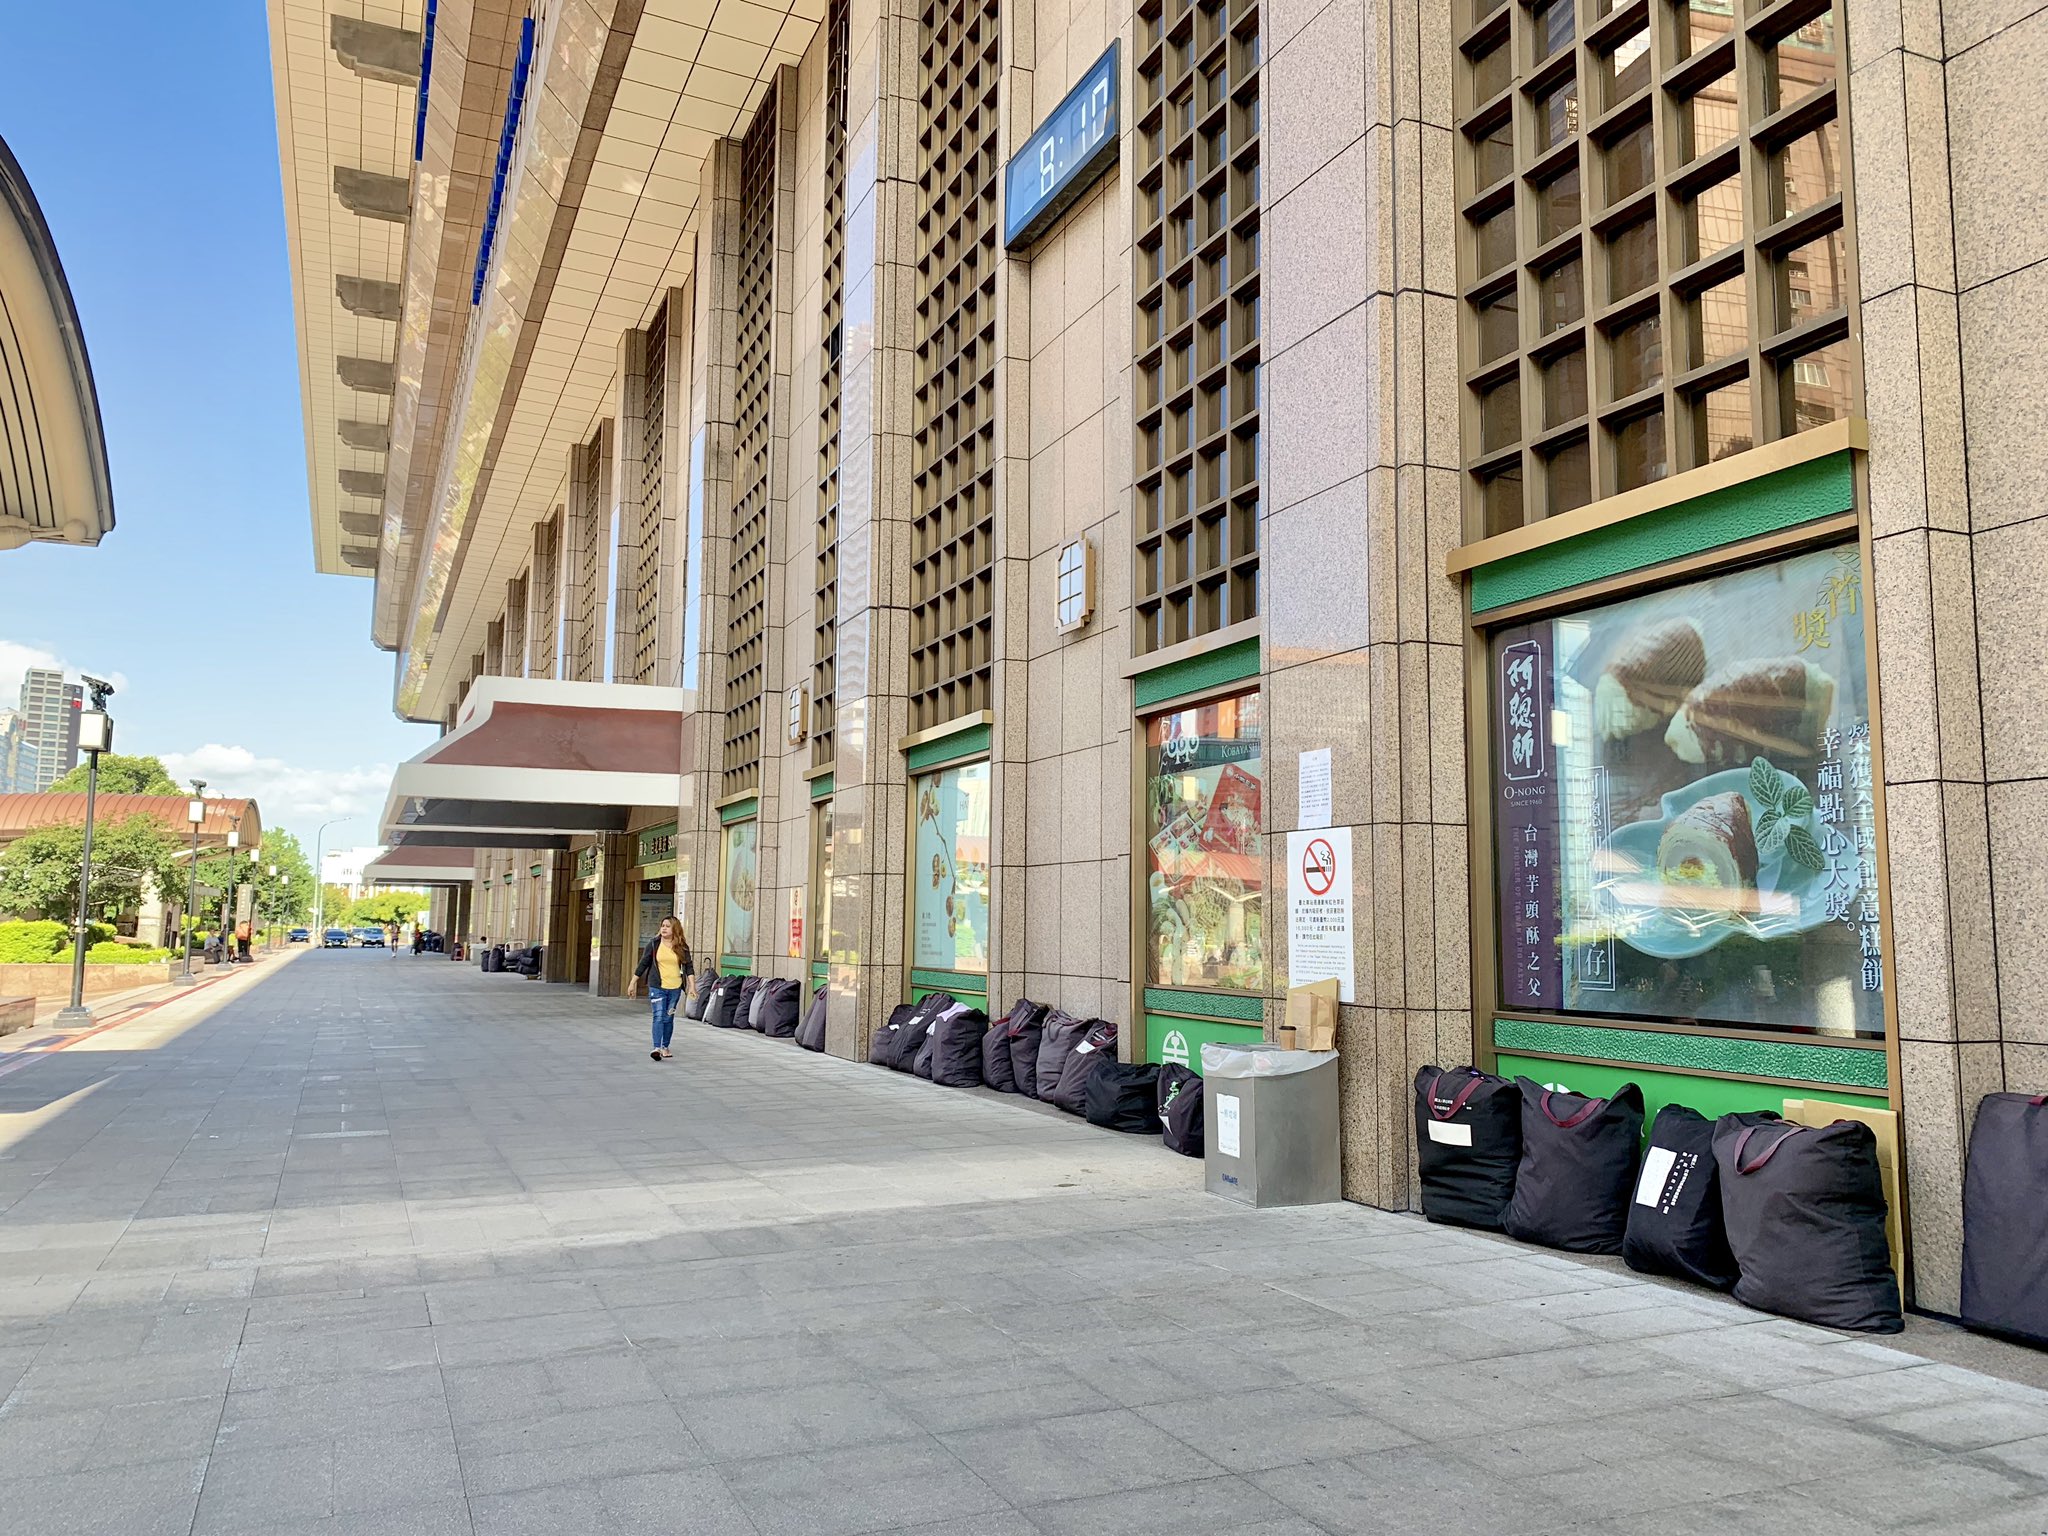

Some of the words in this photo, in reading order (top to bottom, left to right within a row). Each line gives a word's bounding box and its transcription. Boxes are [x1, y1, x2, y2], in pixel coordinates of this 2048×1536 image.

[1040, 77, 1109, 198] 8:10
[1504, 785, 1546, 799] O-NONG
[649, 882, 661, 891] B25
[1524, 823, 1541, 997] 台灣芋頭酥之父
